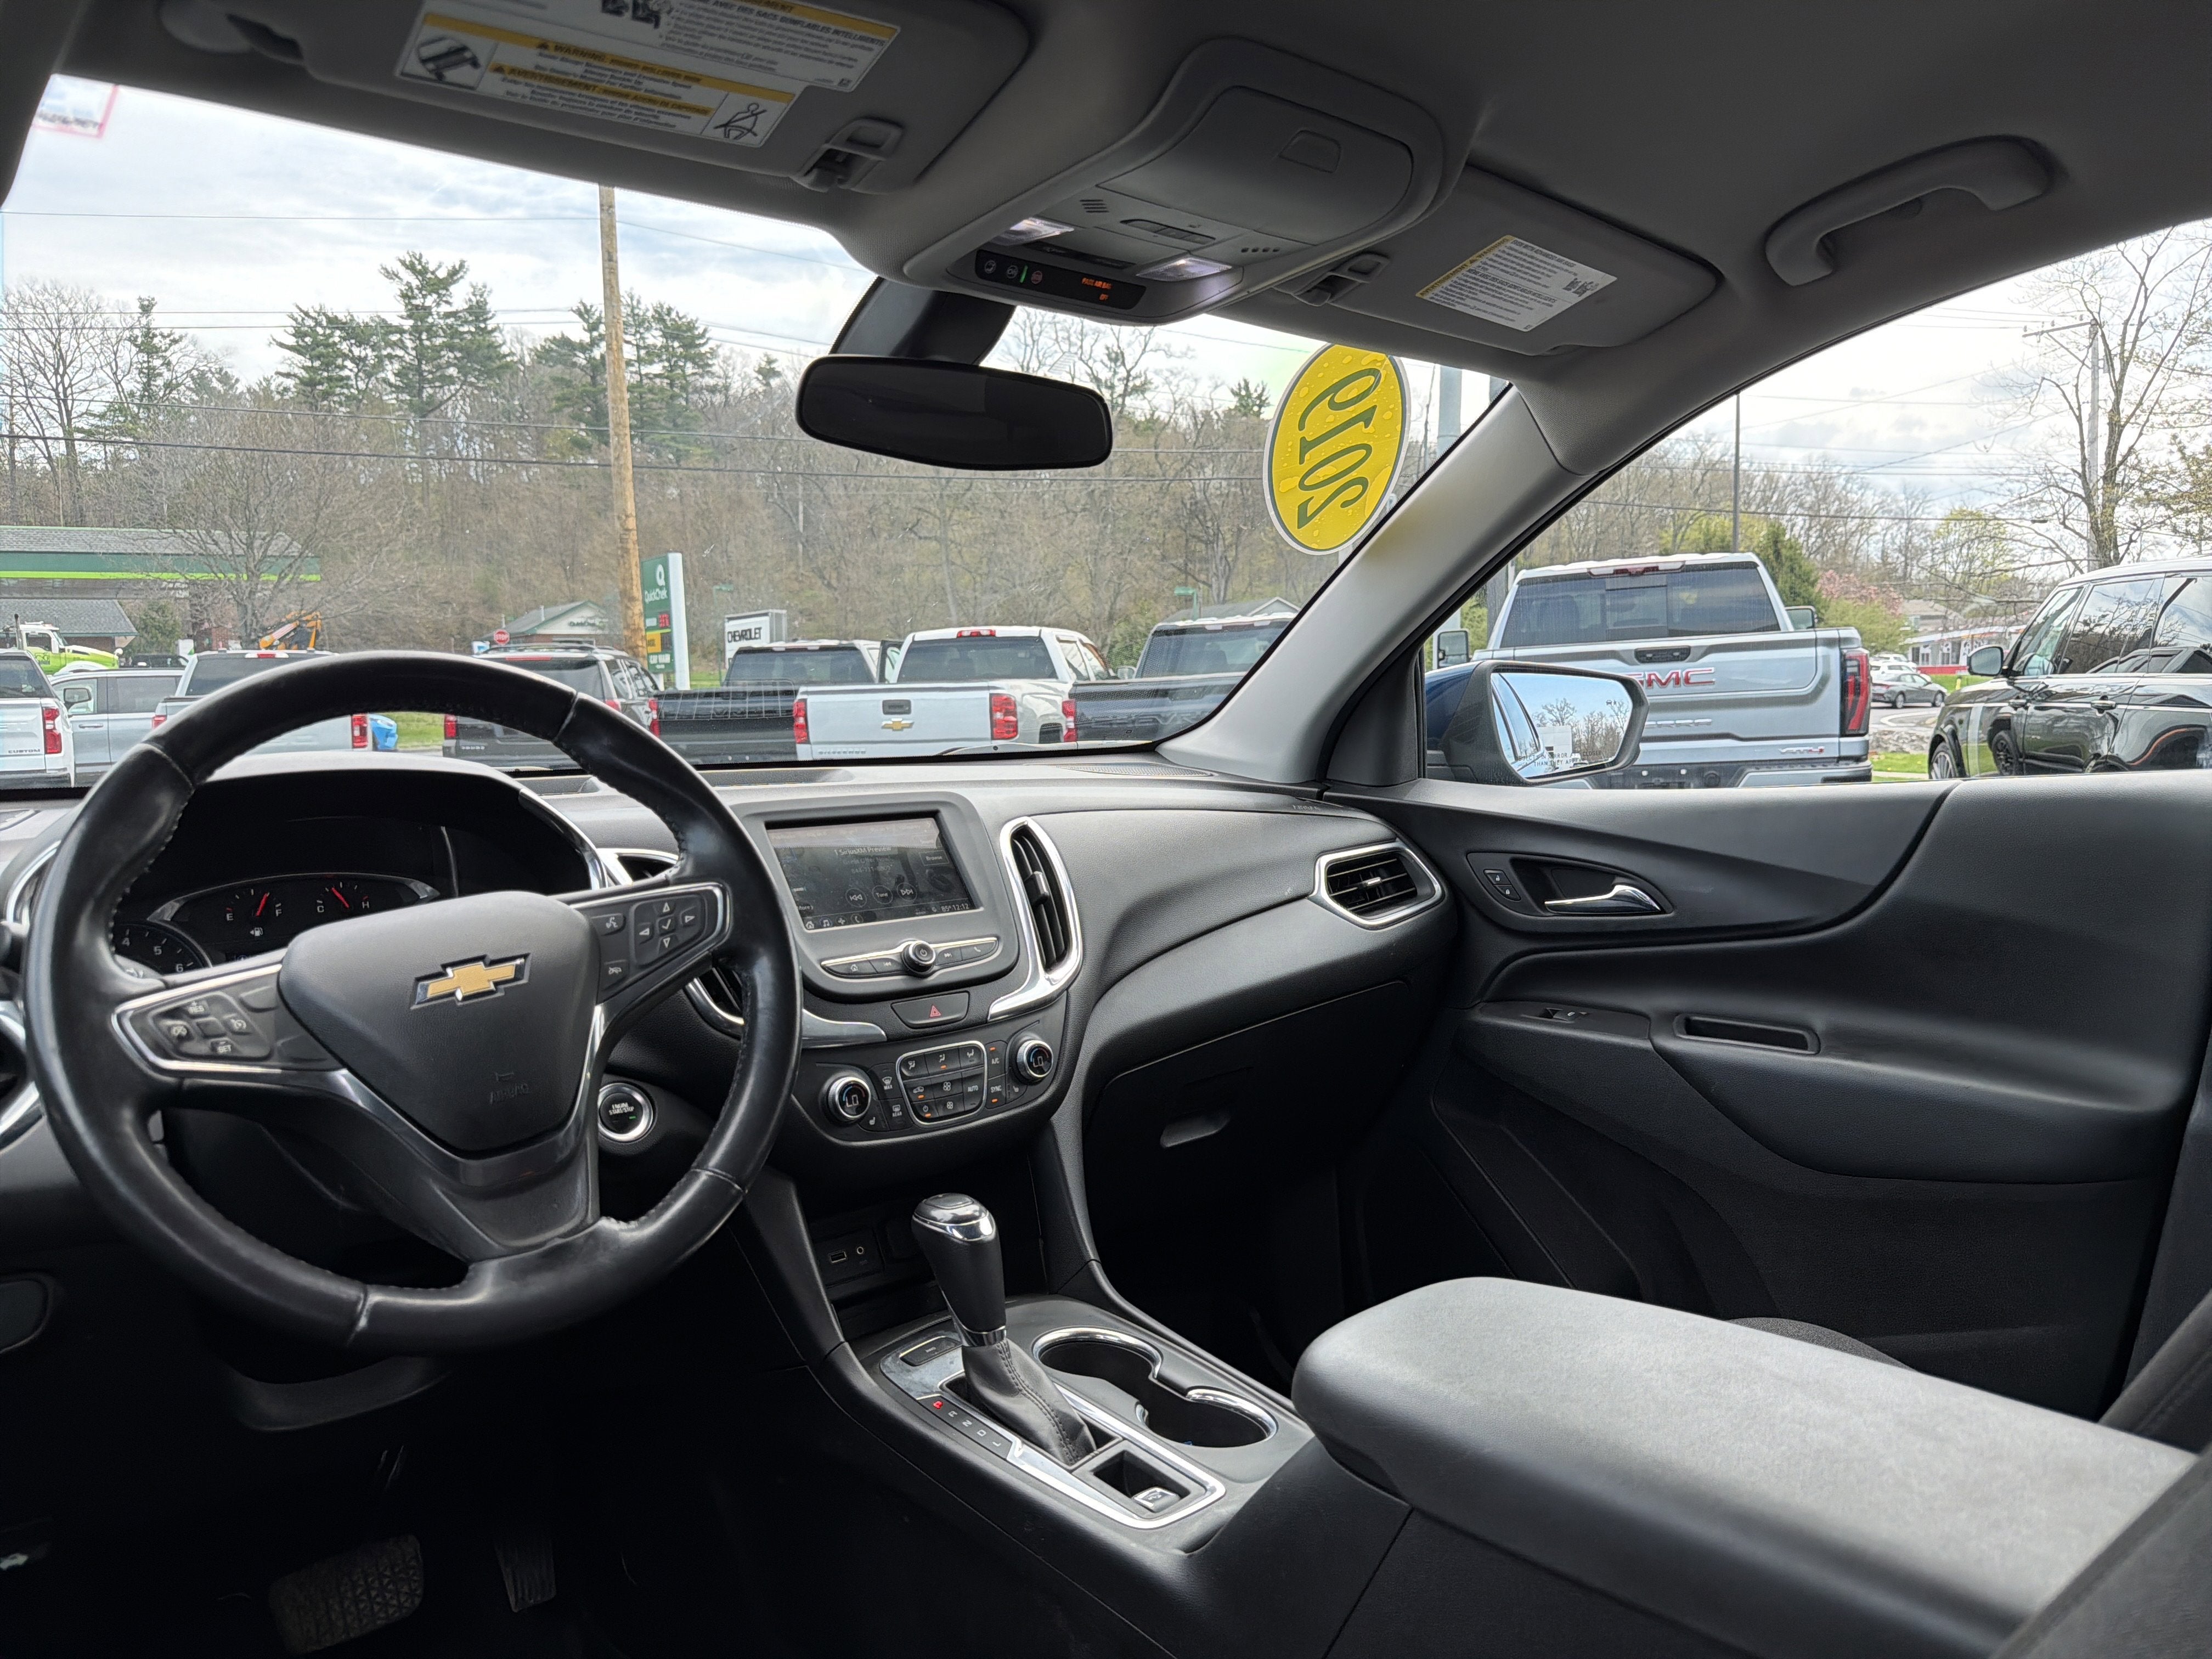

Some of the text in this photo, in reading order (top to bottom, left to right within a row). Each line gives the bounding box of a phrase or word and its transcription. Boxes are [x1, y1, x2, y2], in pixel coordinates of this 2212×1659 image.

[656, 563, 665, 586] Q
[727, 627, 762, 643] CHEVROLET
[952, 904, 970, 912] 12:12
[122, 938, 130, 946] 4
[154, 946, 162, 955] 5
[176, 963, 184, 973] 6
[188, 1005, 205, 1014] RES
[217, 1045, 232, 1053] SET
[1032, 1056, 1044, 1068] LO
[845, 1094, 859, 1108] LO
